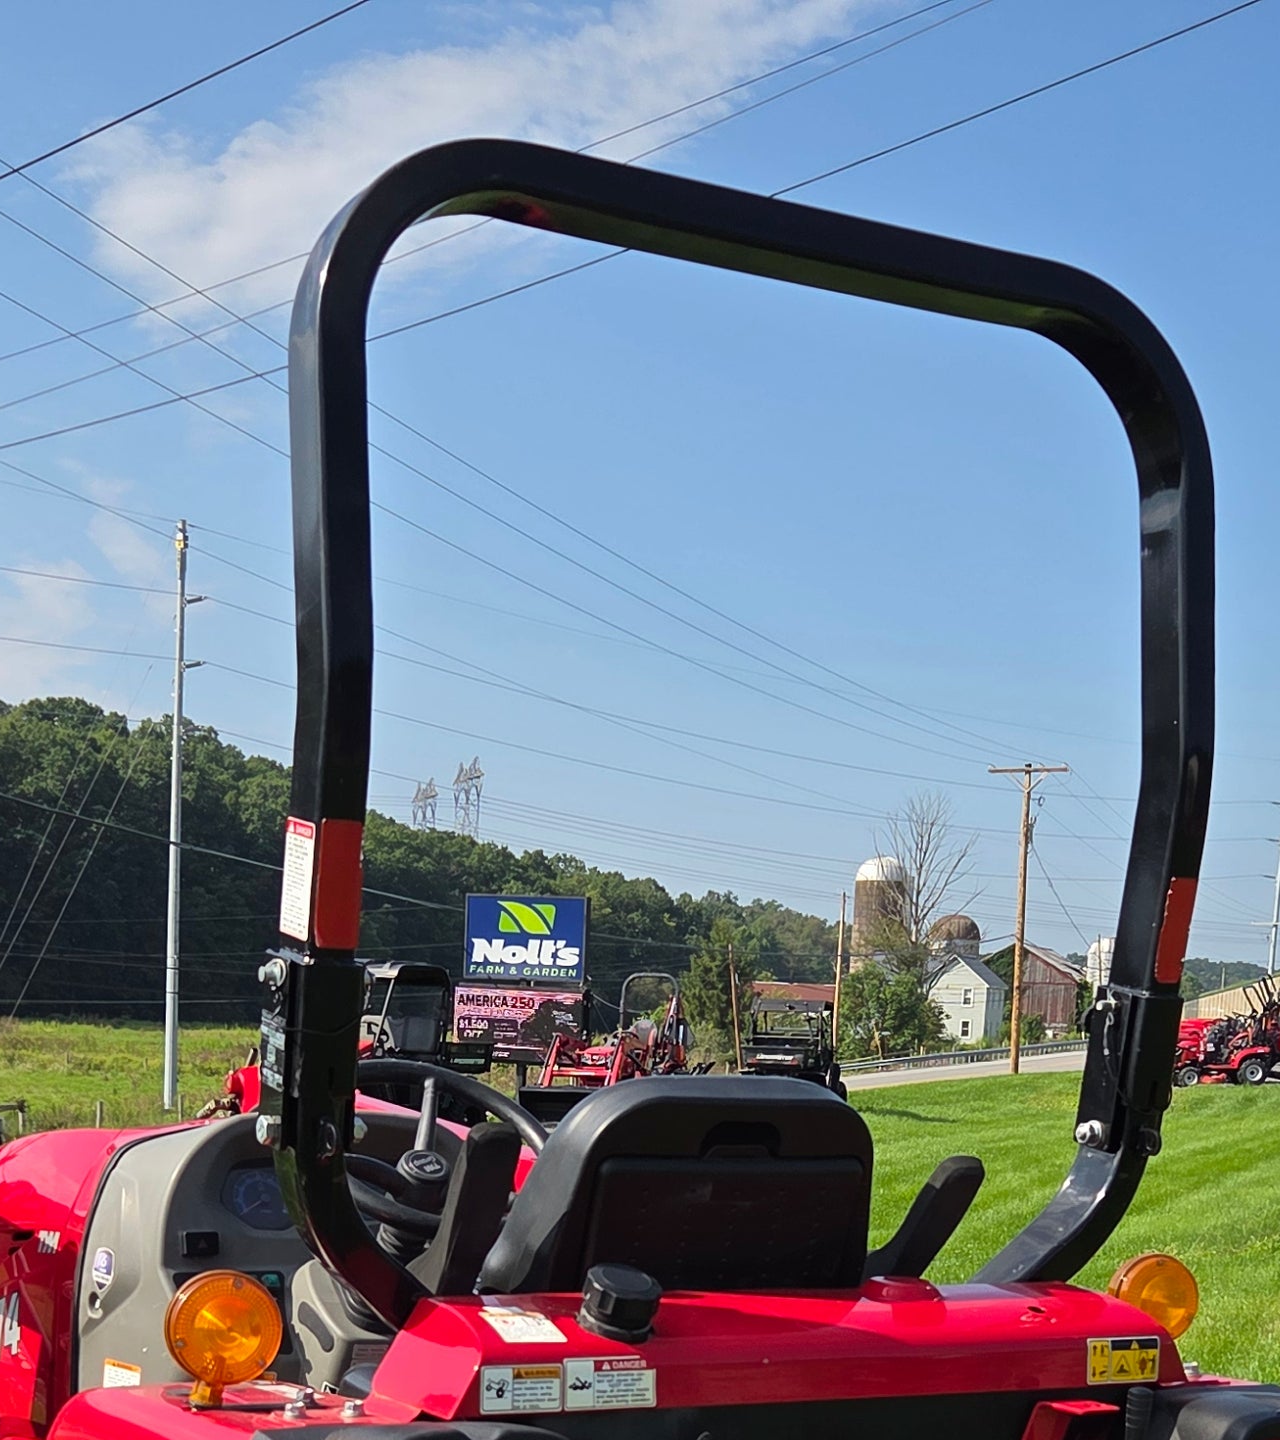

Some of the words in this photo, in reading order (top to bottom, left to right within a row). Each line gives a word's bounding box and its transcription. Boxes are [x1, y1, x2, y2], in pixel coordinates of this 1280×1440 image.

[471, 938, 580, 967] Nolt's
[469, 964, 504, 975] FARM
[509, 966, 518, 975] &
[523, 967, 577, 977] GARDEN
[457, 994, 509, 1008] AMERICA
[612, 1360, 647, 1369] DANGER
